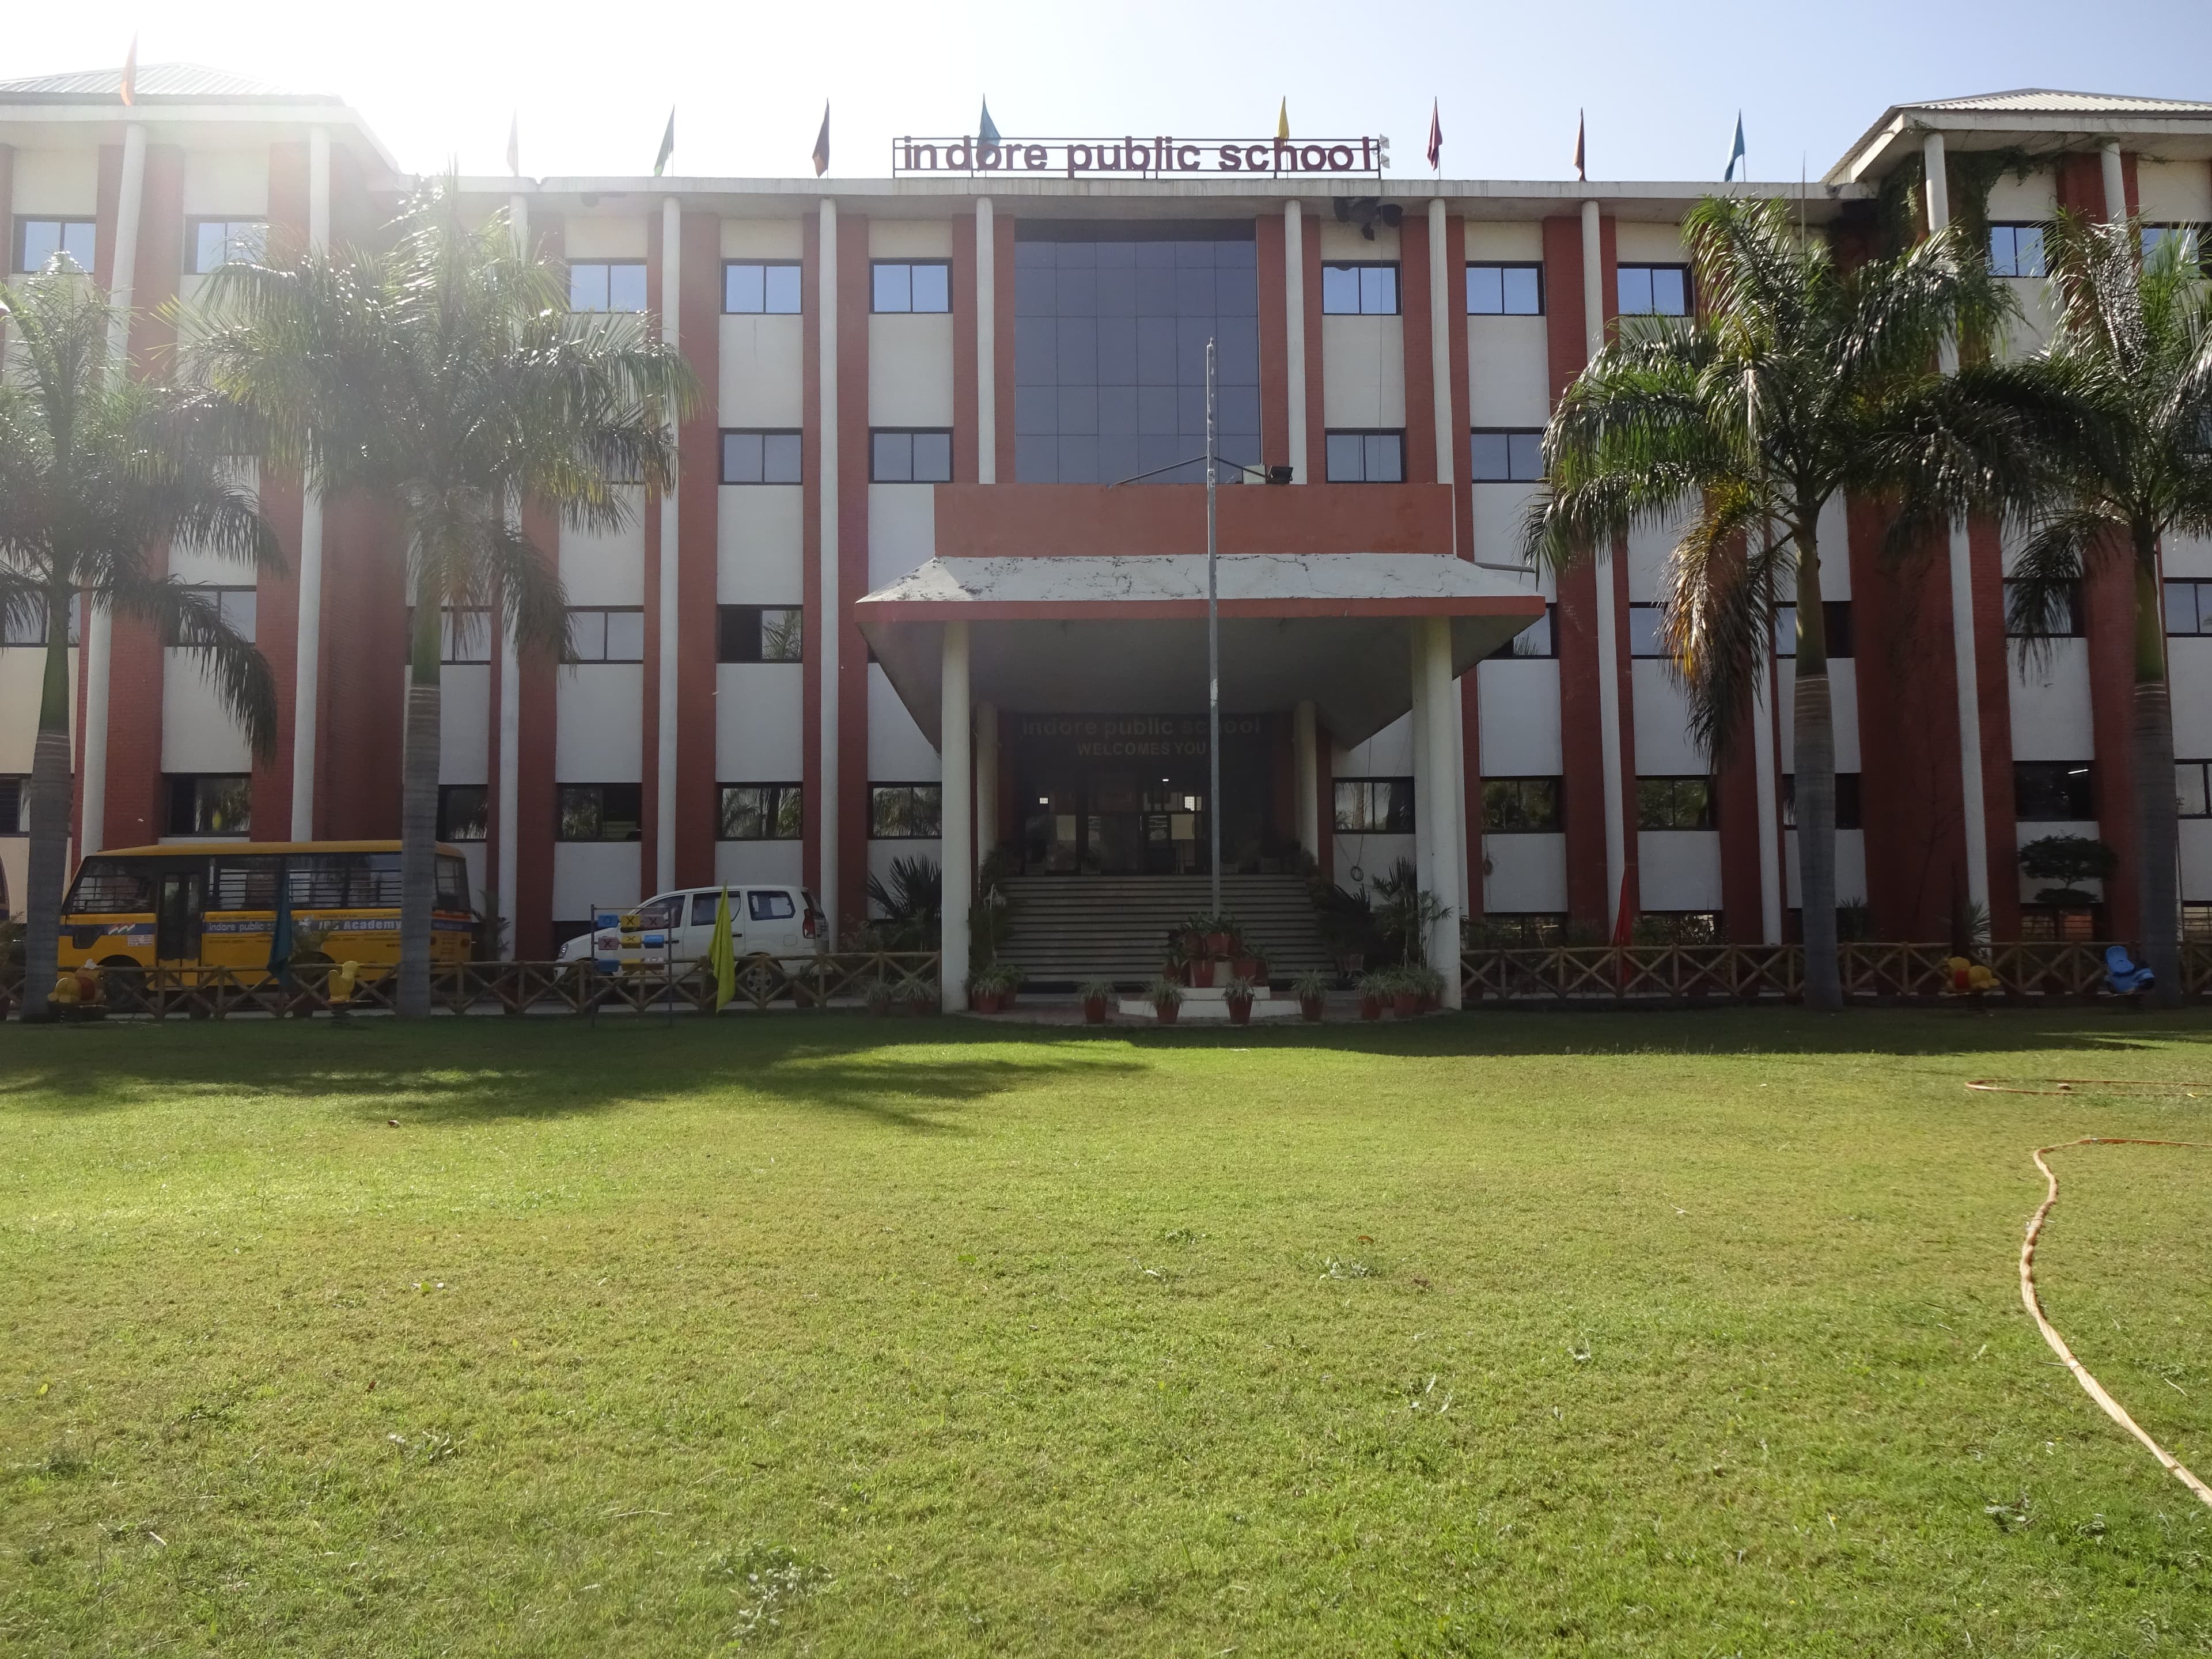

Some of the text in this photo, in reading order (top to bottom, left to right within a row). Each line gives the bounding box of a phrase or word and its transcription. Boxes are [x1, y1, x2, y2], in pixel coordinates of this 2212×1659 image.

[904, 135, 1370, 179] indore public school
[1023, 716, 1261, 740] indore public scool
[1078, 742, 1206, 756] WELCOMES YOU
[239, 922, 263, 932] public
